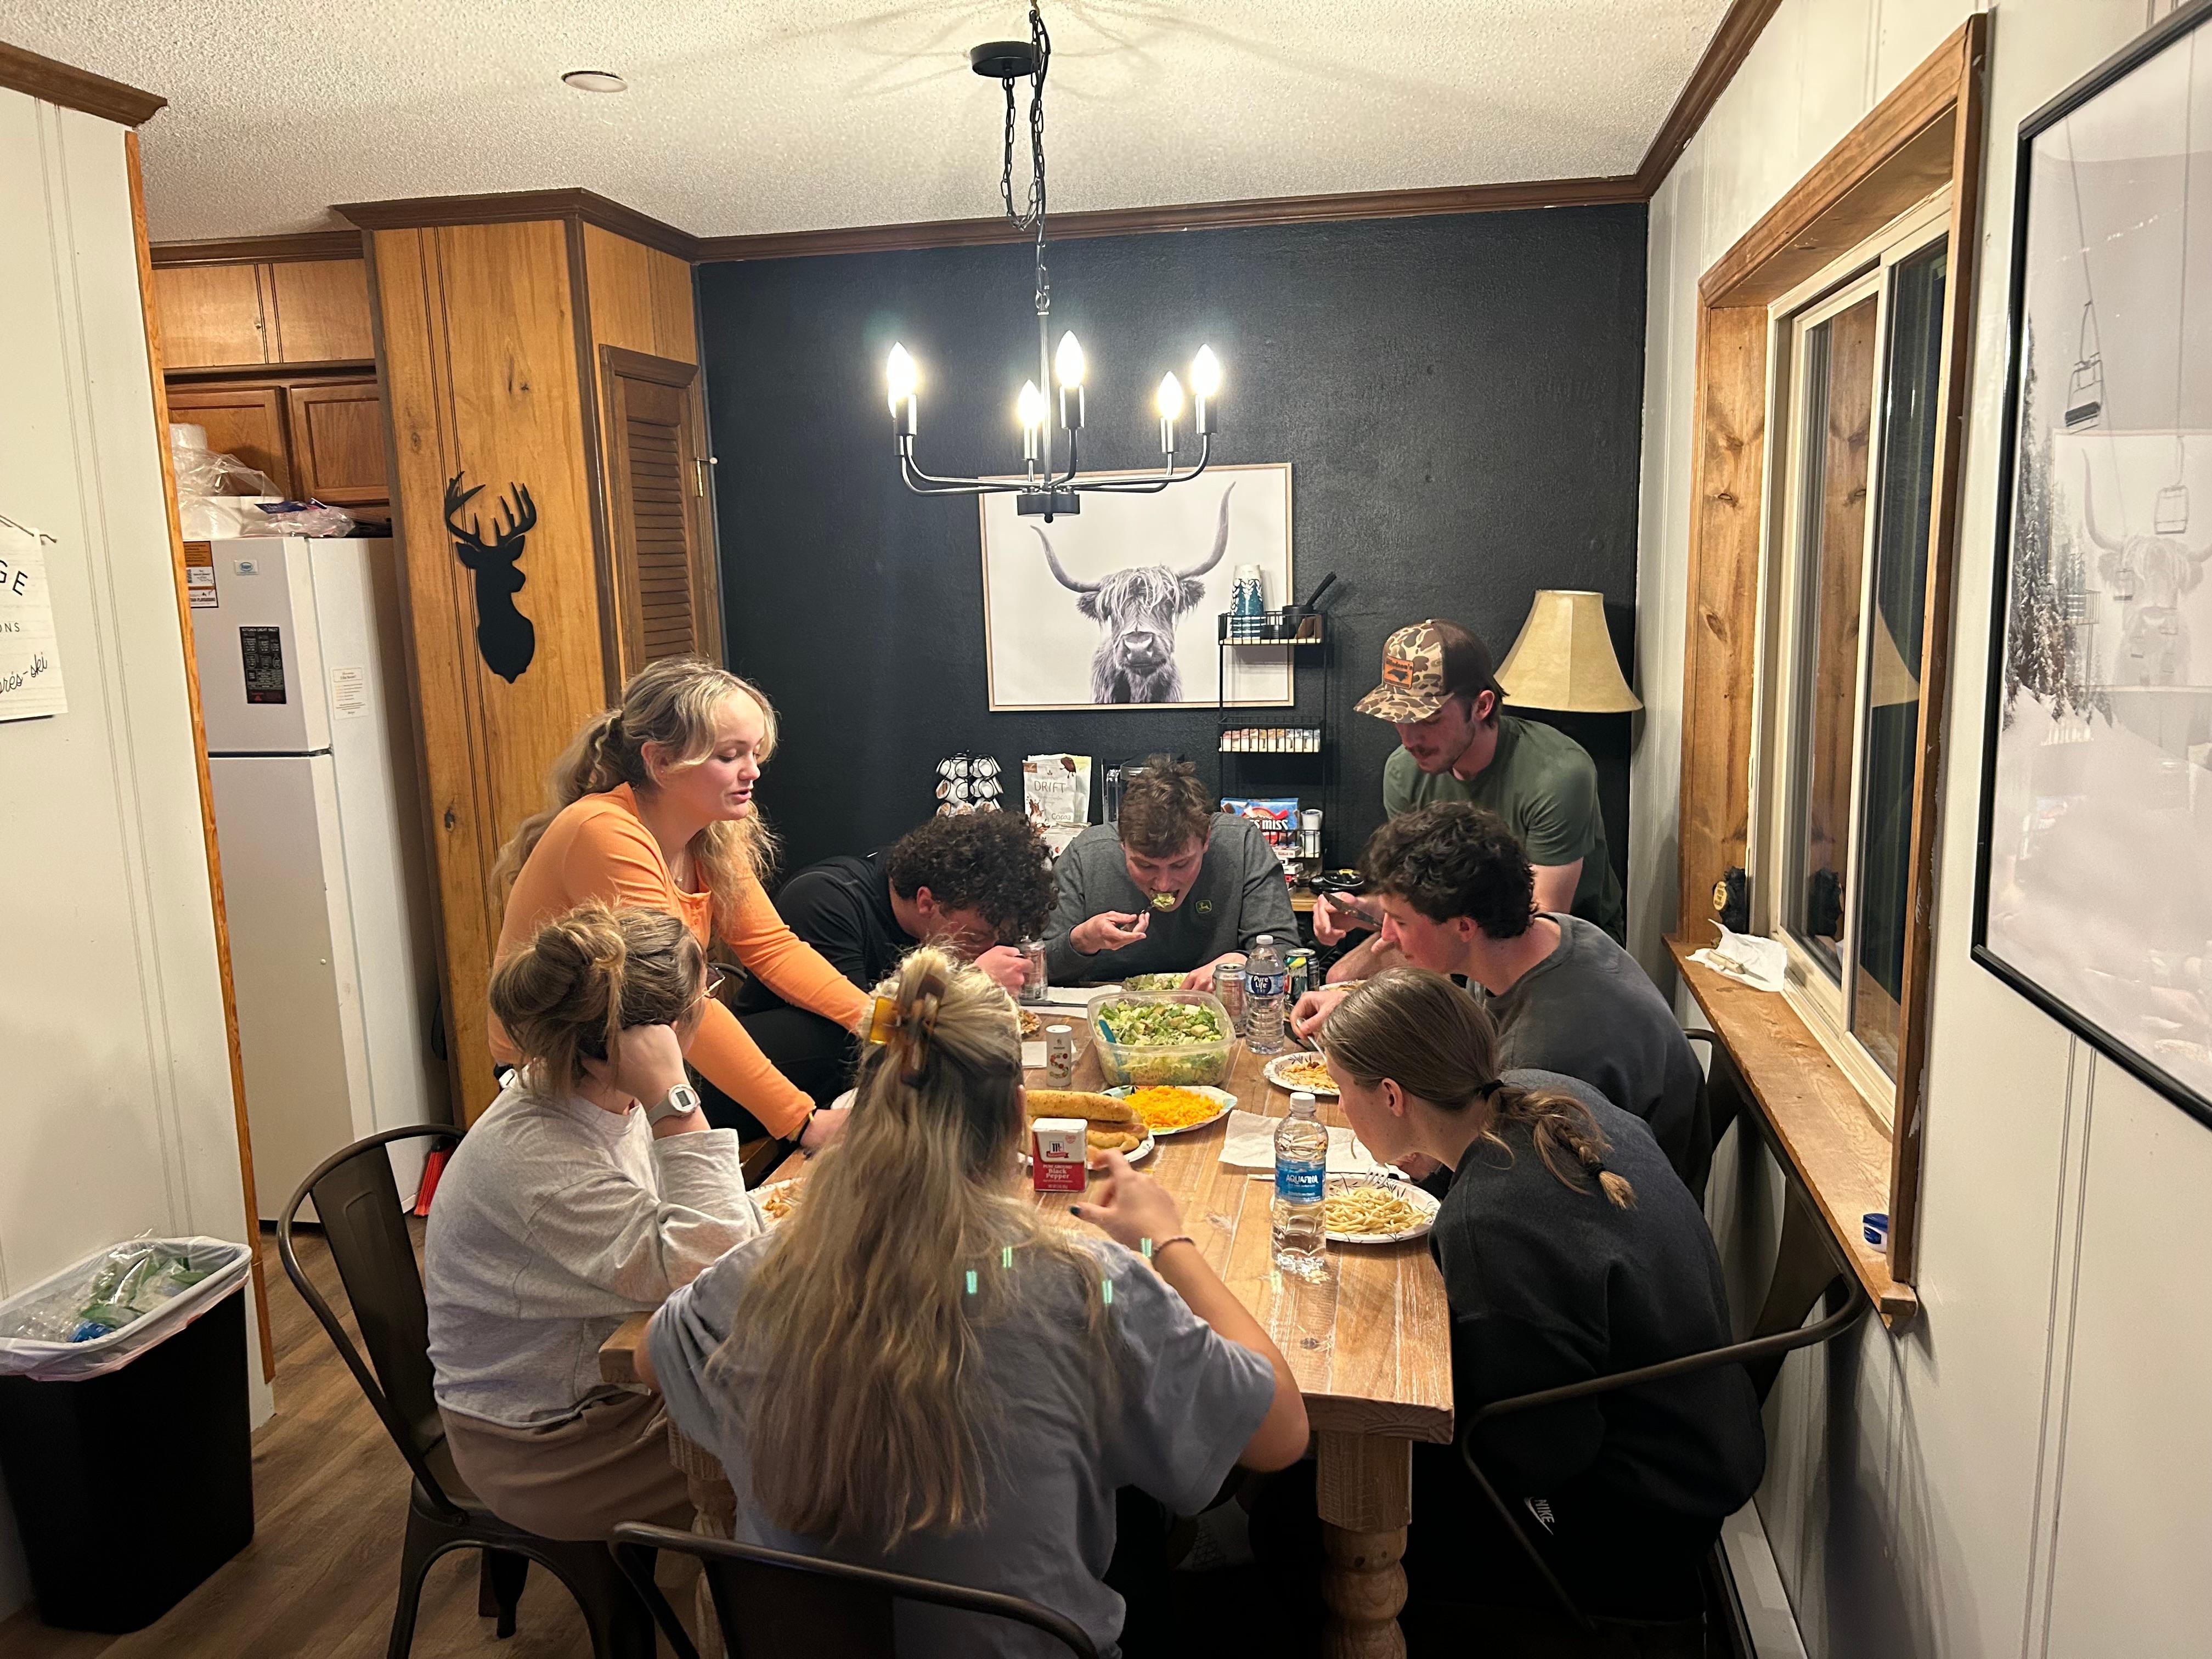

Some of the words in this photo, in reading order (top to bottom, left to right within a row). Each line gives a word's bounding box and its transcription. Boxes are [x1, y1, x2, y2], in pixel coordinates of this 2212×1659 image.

[1034, 781, 1066, 793] DRIFT
[1051, 812, 1071, 821] Cocoa
[1255, 981, 1267, 990] Life
[1534, 1499, 1555, 1523] NIKE
